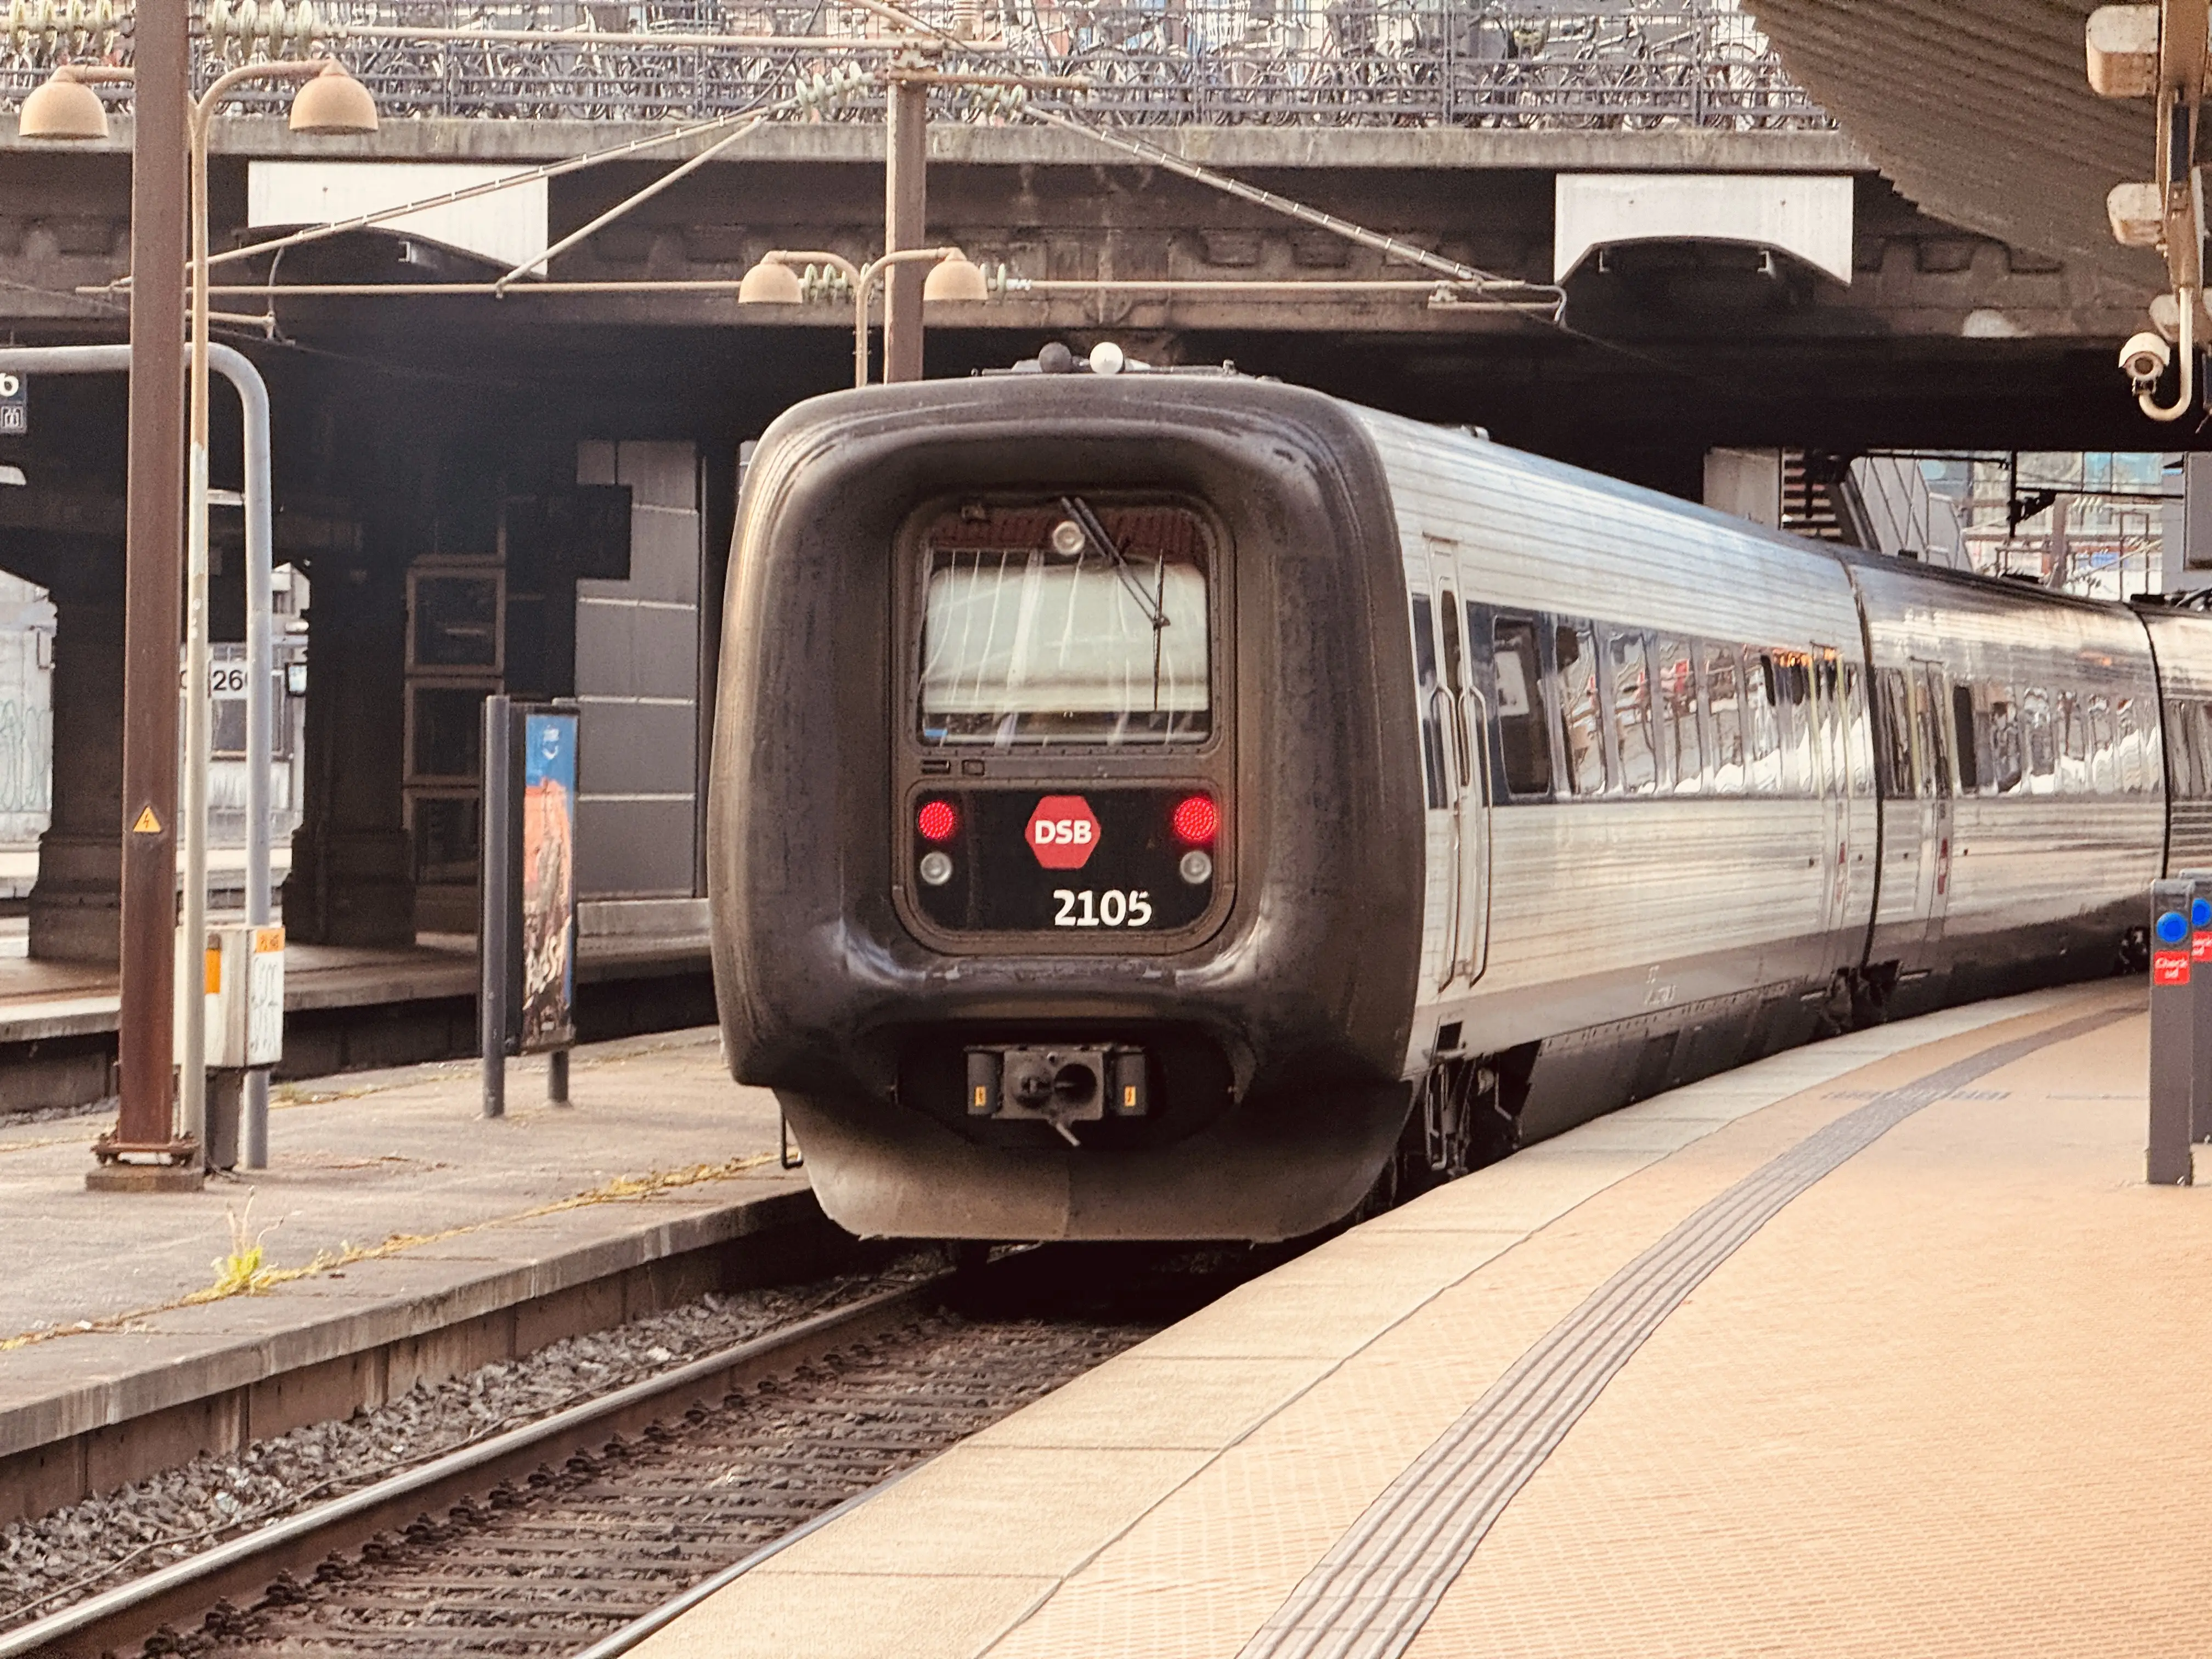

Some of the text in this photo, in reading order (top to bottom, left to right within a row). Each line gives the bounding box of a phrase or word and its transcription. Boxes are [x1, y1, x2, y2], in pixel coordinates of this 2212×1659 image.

[212, 669, 248, 691] 26
[1035, 820, 1092, 844] DSB
[1053, 889, 1152, 926] 2105
